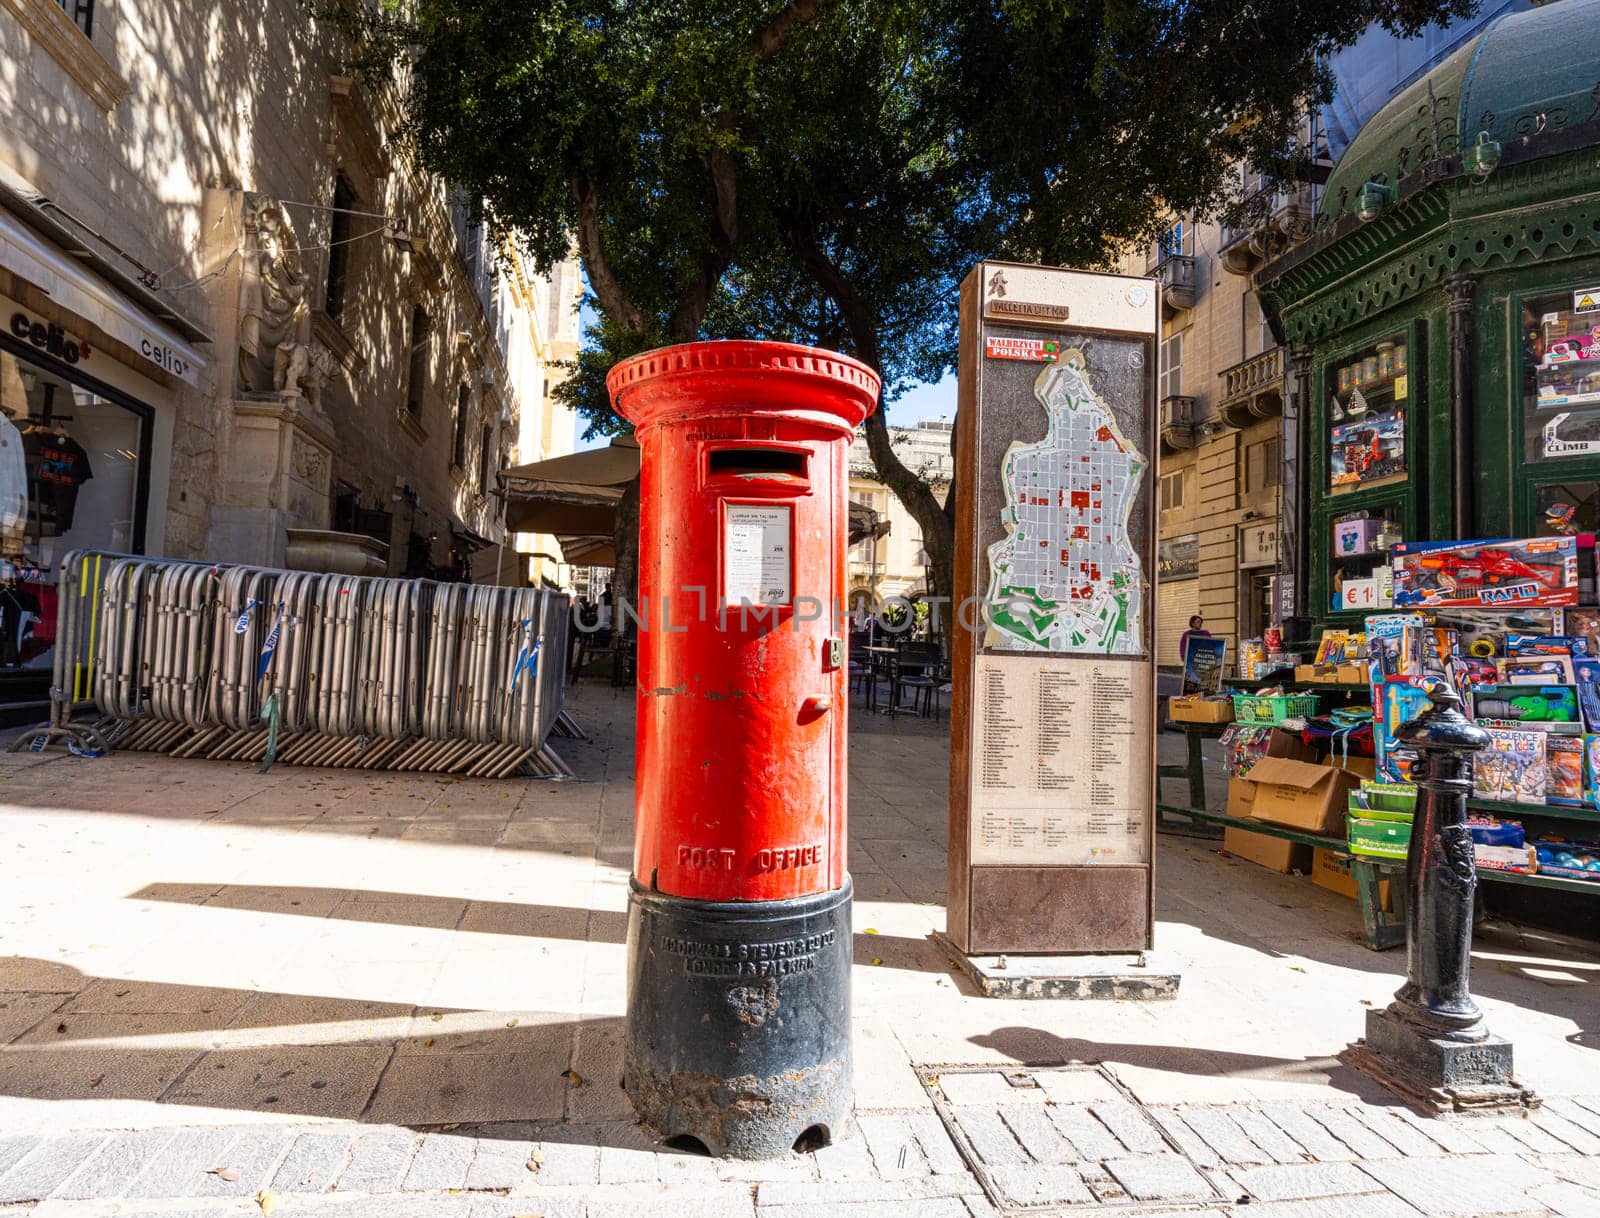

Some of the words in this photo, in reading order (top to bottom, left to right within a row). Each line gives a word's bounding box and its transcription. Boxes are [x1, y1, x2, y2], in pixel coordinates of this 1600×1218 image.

[10, 312, 80, 364] celio
[141, 339, 183, 375] celio
[993, 347, 1038, 359] POLSKA
[1547, 442, 1589, 452] CLIMB
[1478, 583, 1539, 604] RAPID
[1491, 730, 1537, 741] SEQUENCE
[1496, 739, 1512, 752] for
[678, 845, 736, 871] POST
[758, 844, 823, 872] OFFICE
